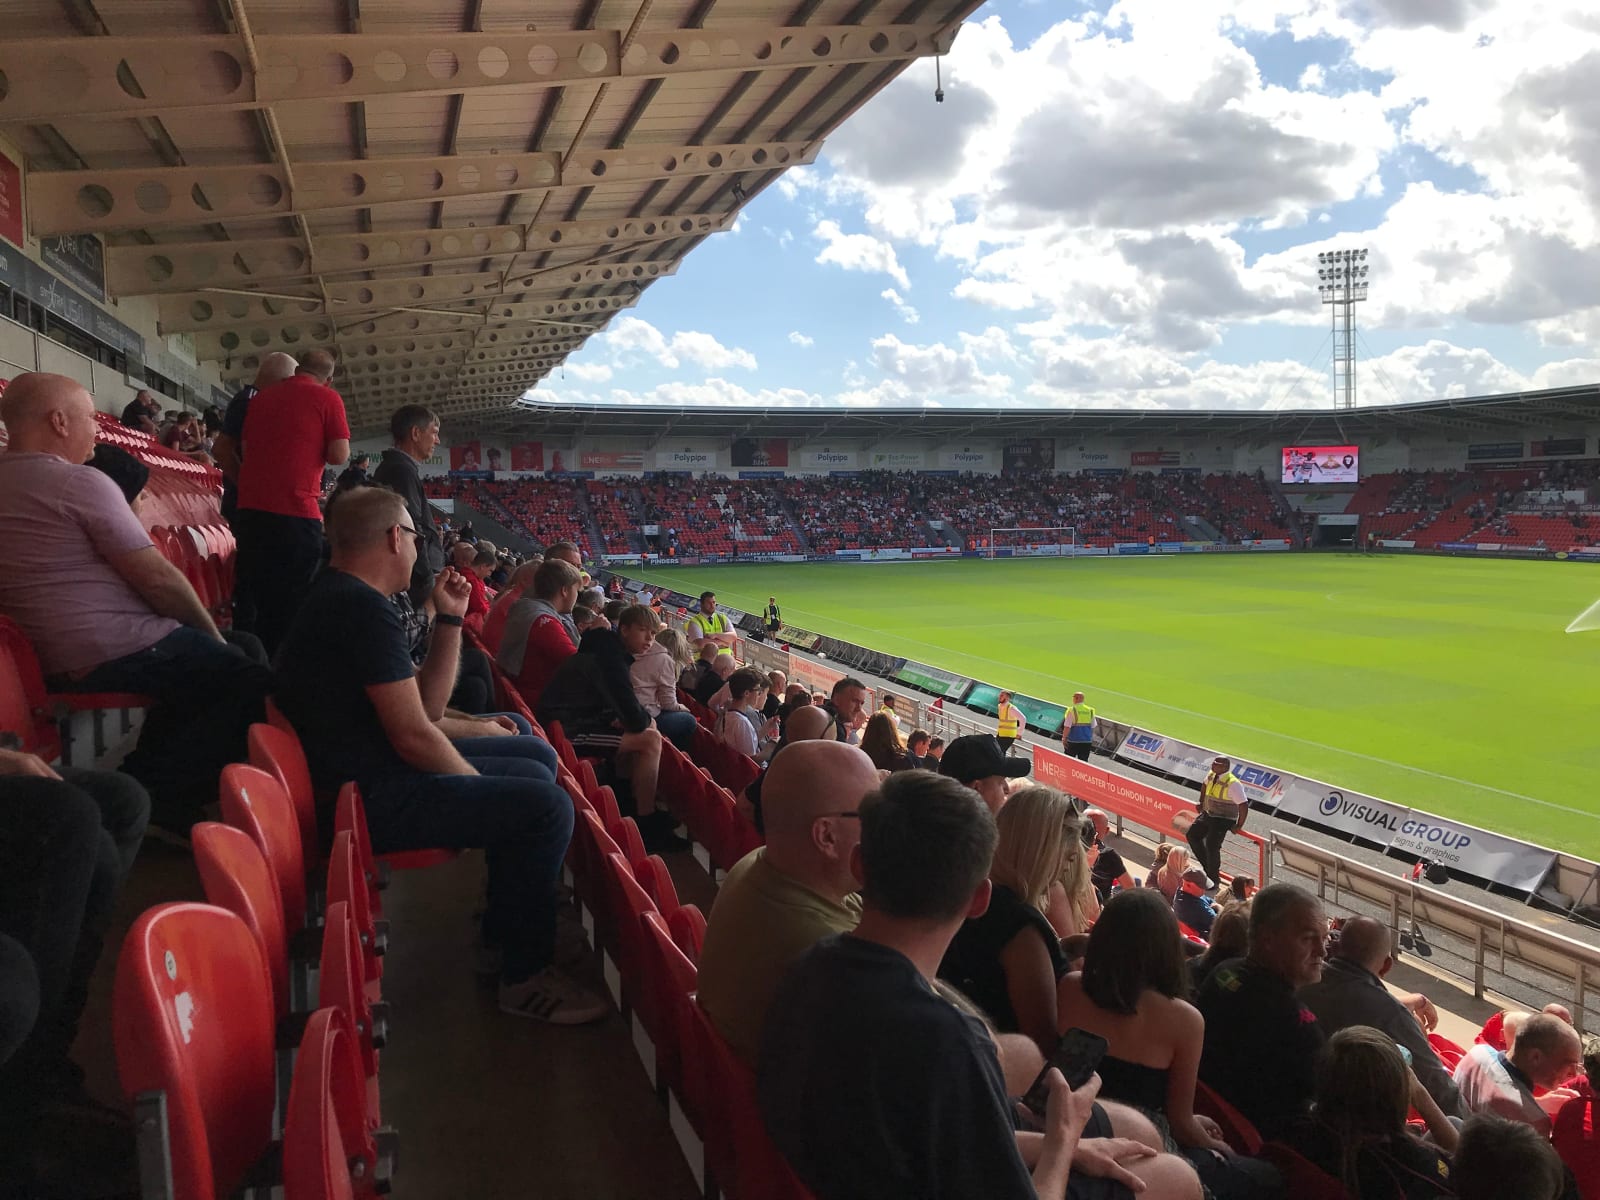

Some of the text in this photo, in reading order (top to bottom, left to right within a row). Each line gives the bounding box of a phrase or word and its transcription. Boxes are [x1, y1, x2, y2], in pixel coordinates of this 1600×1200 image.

[674, 454, 707, 463] Polypipe
[817, 453, 848, 463] Polypipe
[954, 453, 984, 463] Polypipe
[1081, 452, 1109, 462] Polypipe
[1126, 732, 1163, 753] LEW
[1037, 759, 1060, 778] LNER
[1231, 764, 1280, 788] LEW
[1071, 769, 1106, 788] DONCASTER
[1107, 782, 1116, 793] TO
[1117, 786, 1145, 803] LONDON
[1342, 800, 1471, 850] VISUAL GROUP
[1394, 836, 1461, 863] signs & graphics
